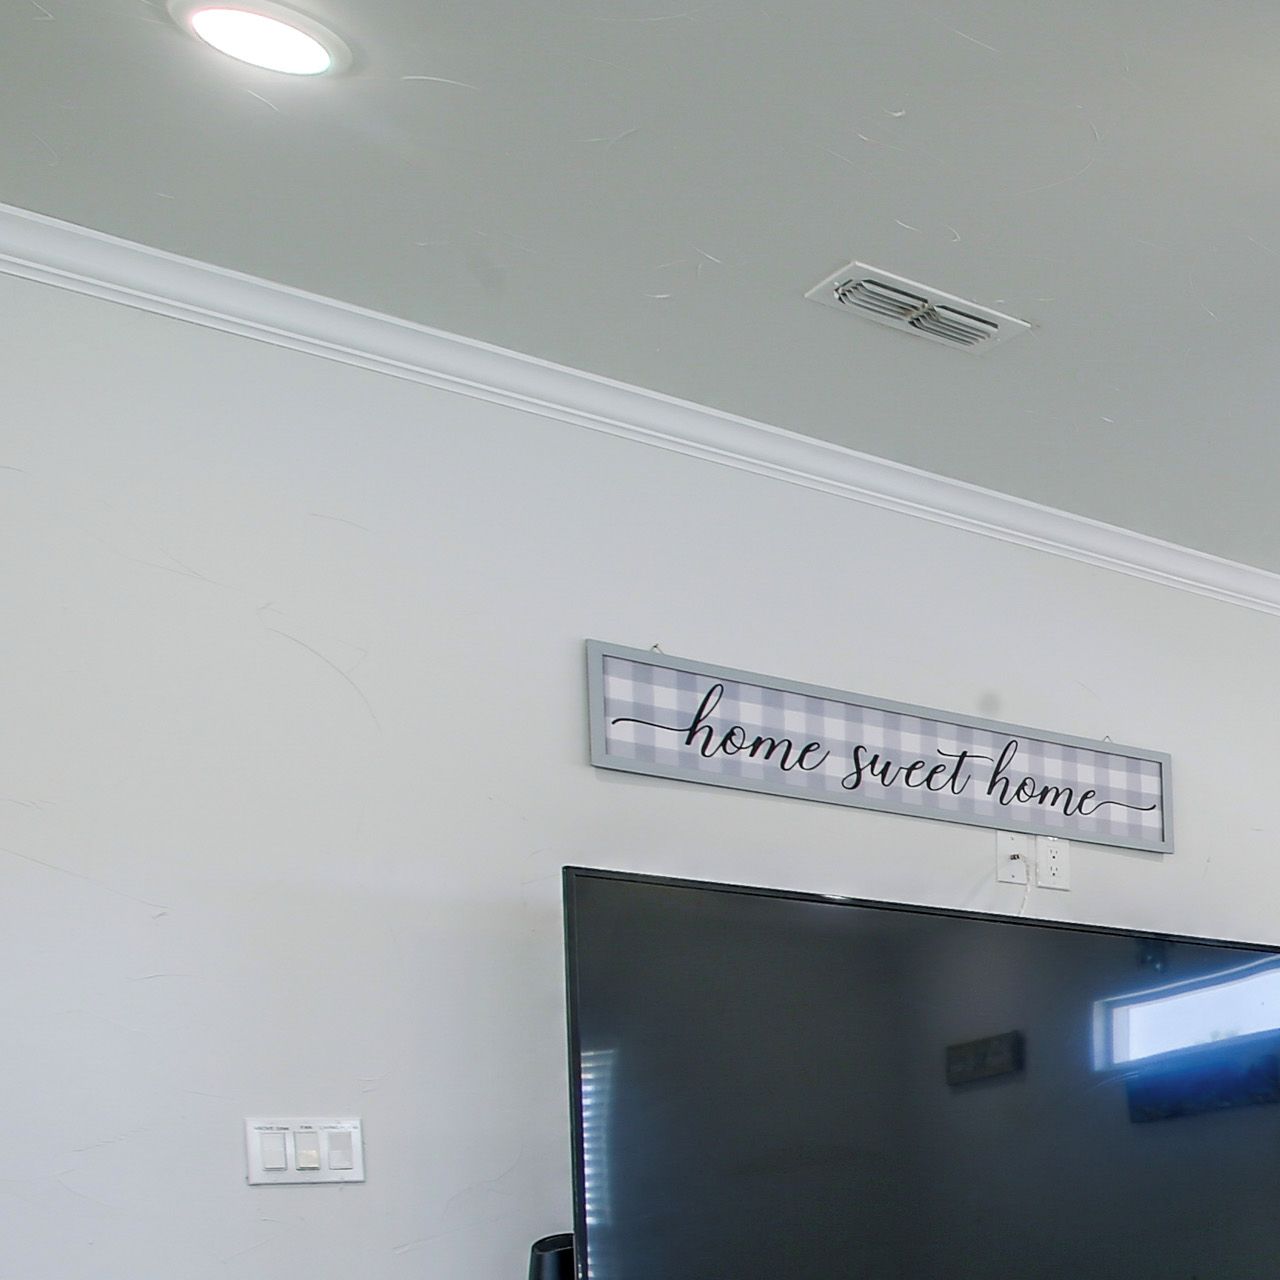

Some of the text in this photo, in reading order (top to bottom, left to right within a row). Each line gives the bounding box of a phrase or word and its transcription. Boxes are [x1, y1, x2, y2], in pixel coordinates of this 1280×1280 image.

[611, 683, 1157, 817] home sweet home
